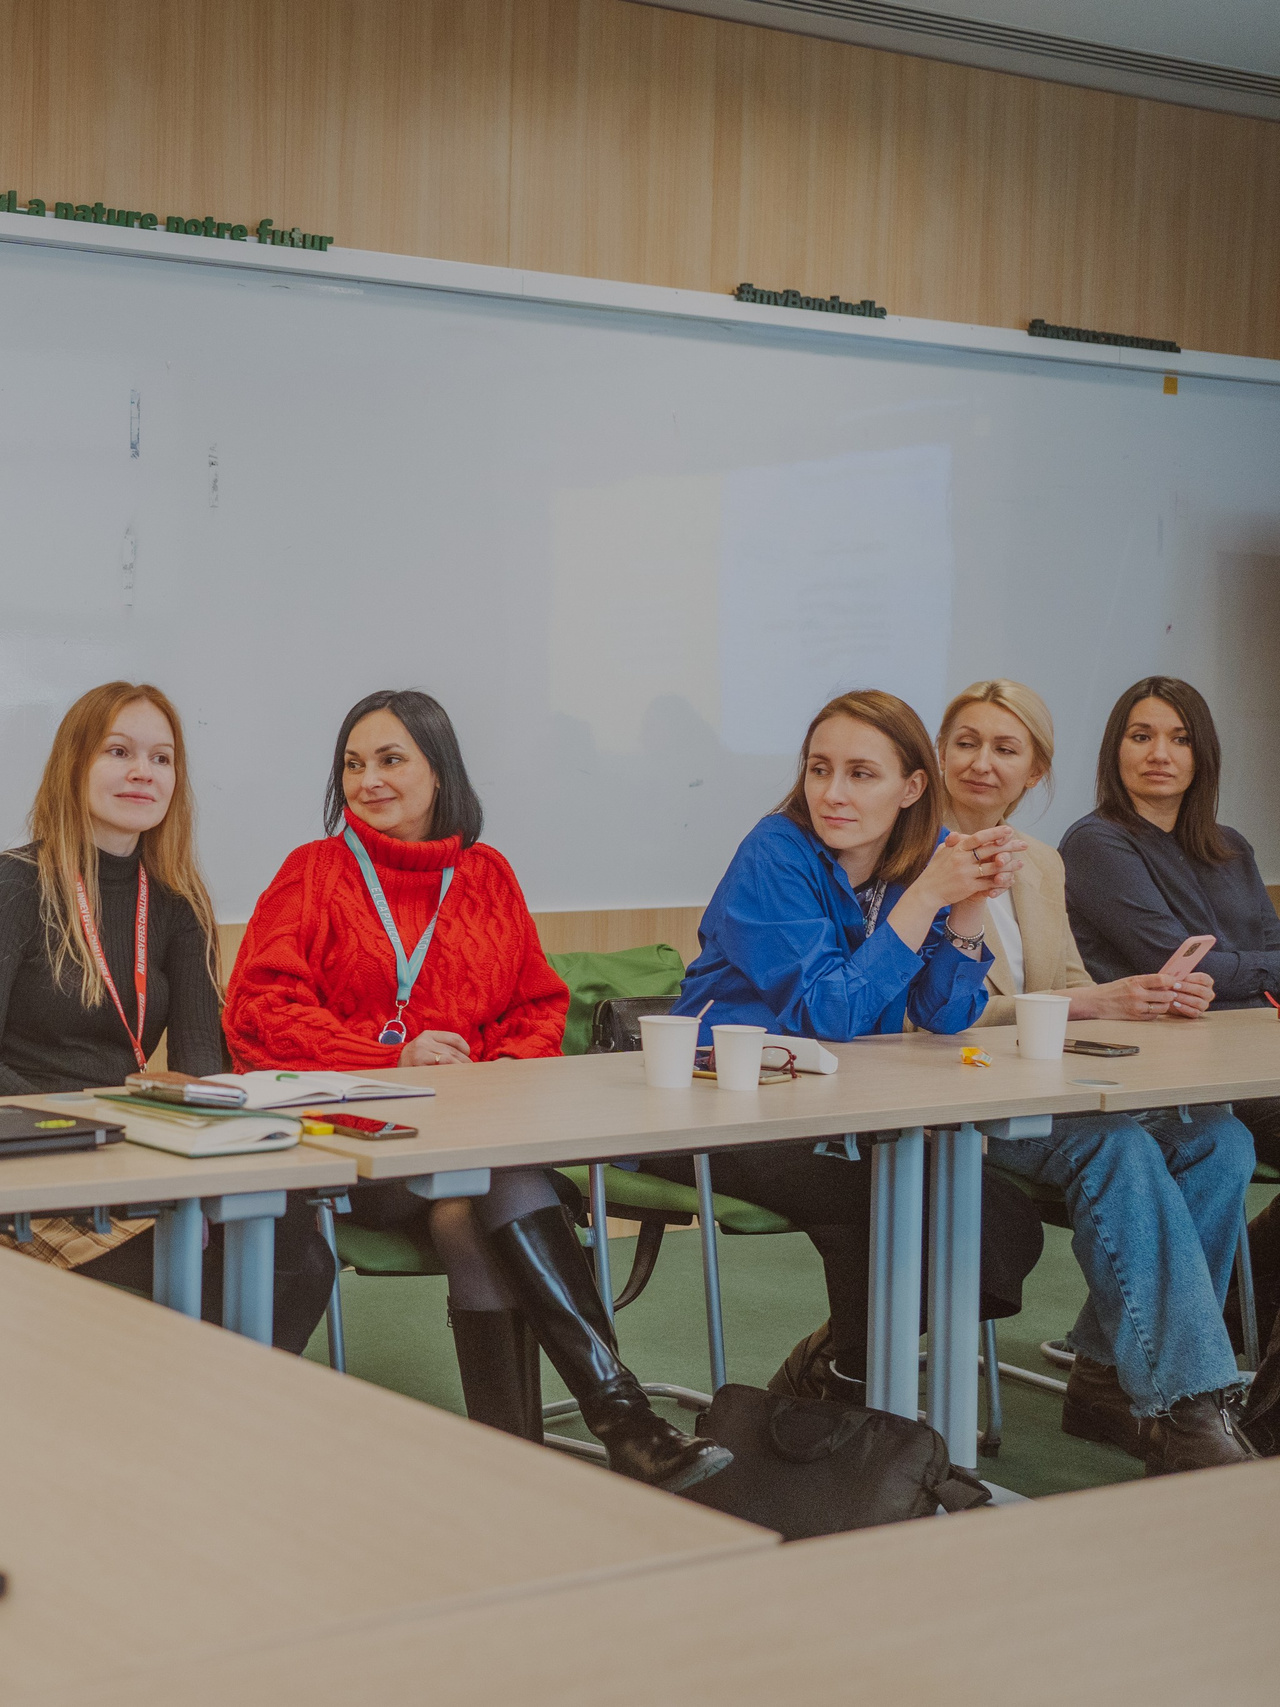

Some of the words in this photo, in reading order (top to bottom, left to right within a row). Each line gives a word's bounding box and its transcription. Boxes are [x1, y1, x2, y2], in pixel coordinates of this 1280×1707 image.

[55, 202, 158, 231] nature
[166, 215, 248, 242] notre
[256, 218, 334, 251] futur
[139, 884, 147, 924] CHALLENGE
[376, 899, 401, 944] CAPULCO
[77, 893, 90, 915] INBEV
[89, 934, 109, 977] CHALLENGE
[137, 943, 145, 963] INBEV
